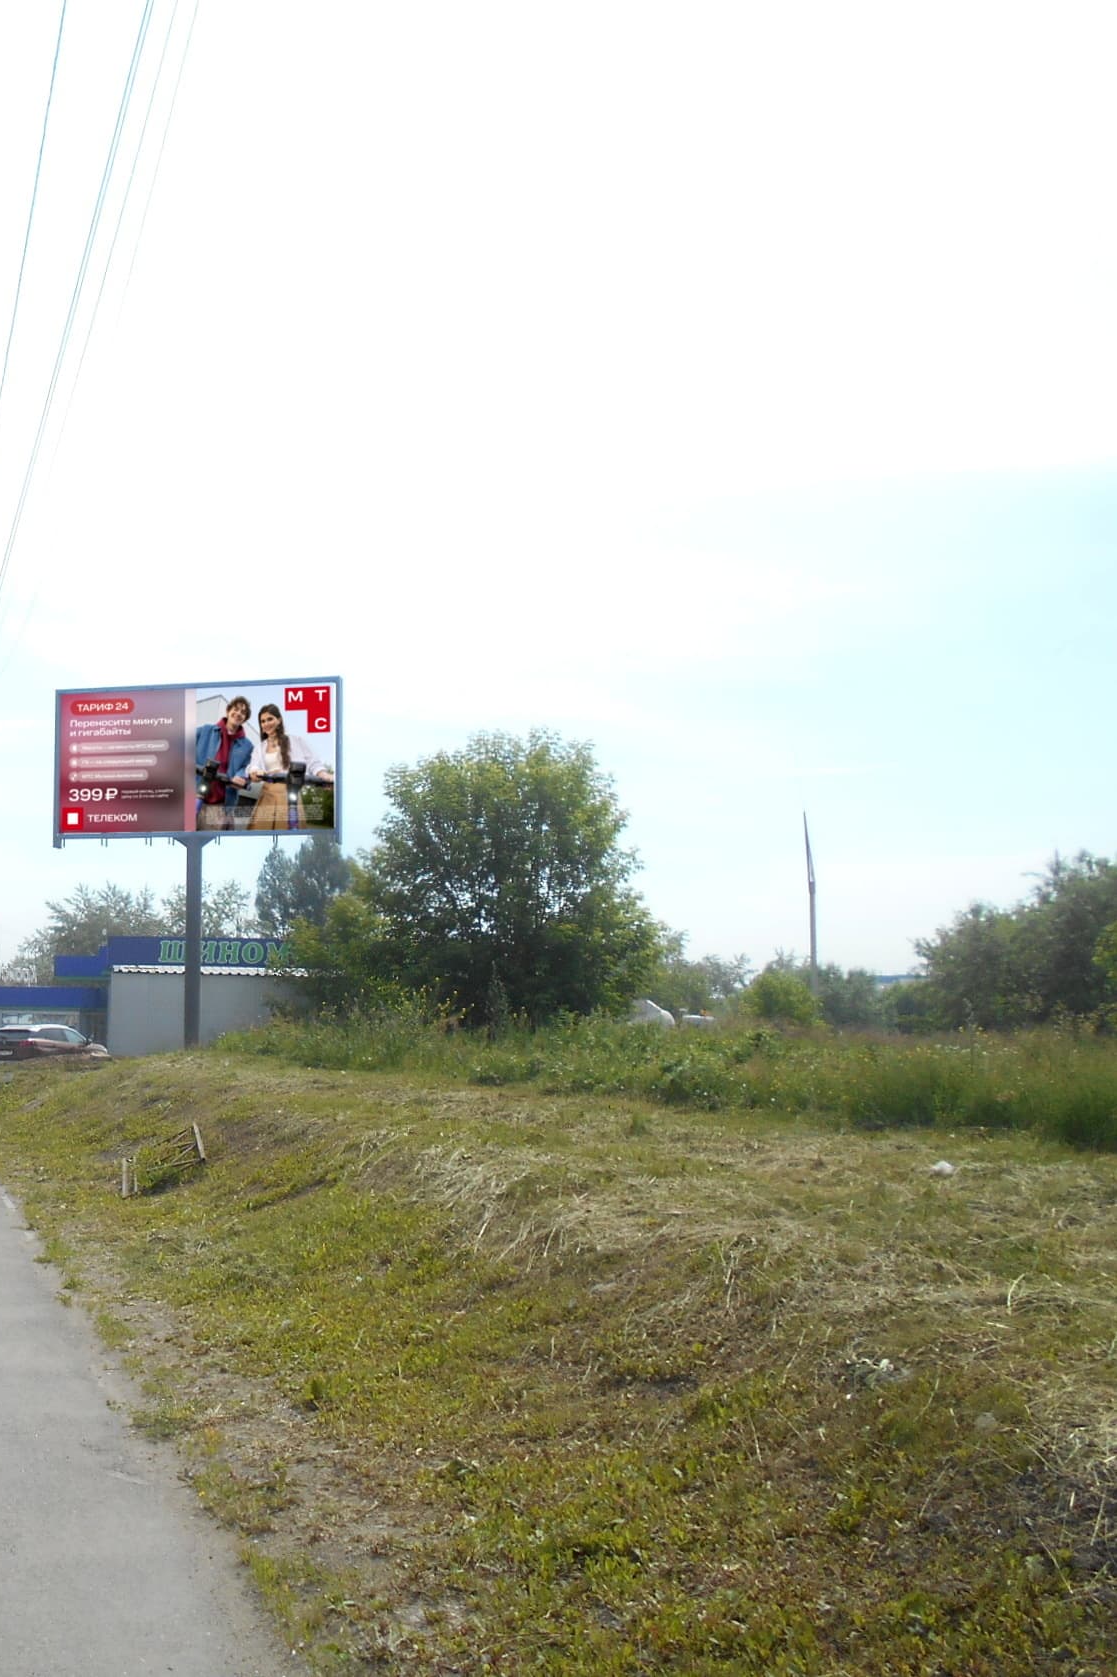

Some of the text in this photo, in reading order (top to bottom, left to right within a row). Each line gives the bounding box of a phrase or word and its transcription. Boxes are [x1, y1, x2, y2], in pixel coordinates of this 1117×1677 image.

[77, 702, 129, 712] ТАРИФ 24
[69, 718, 173, 729] Переносите минуты
[78, 728, 132, 737] гигабайты
[68, 788, 103, 802] 399
[87, 813, 138, 823] ТЕЛЕКОМ
